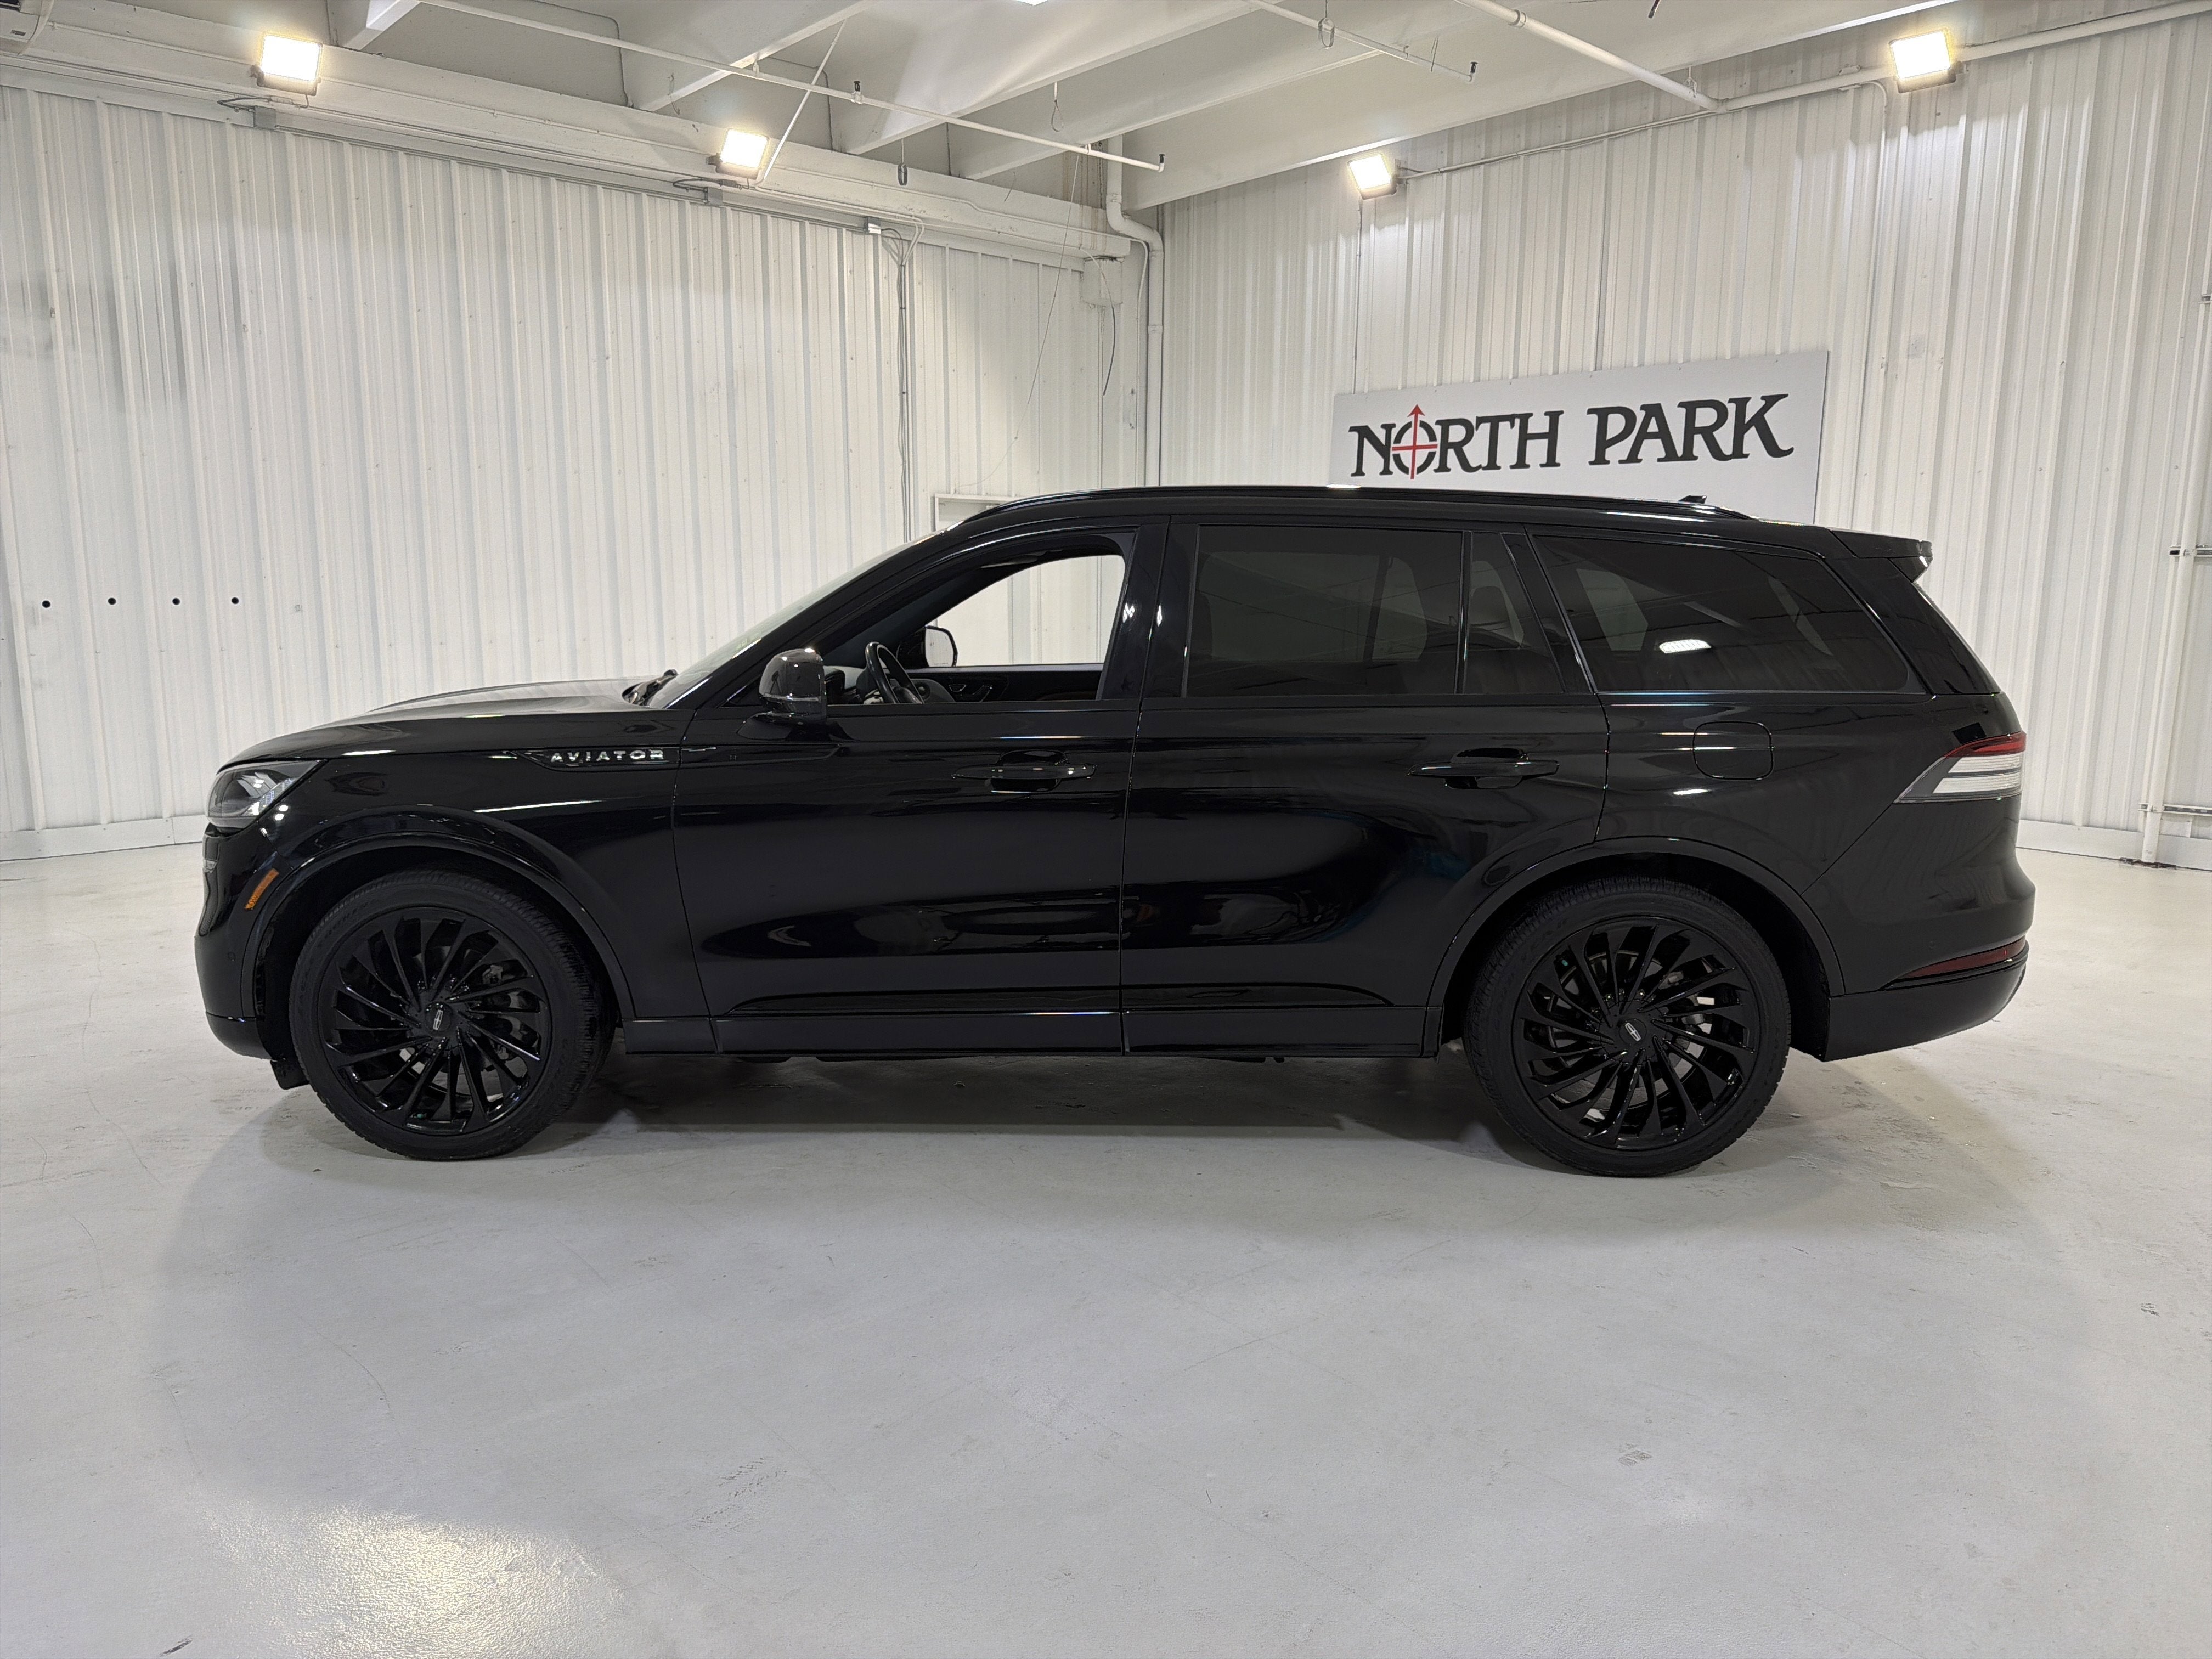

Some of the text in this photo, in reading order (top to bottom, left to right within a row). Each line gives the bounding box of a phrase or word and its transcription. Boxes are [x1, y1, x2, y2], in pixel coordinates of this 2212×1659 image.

[1348, 393, 1794, 477] NORTH PARK
[551, 749, 664, 763] AVIATOR
